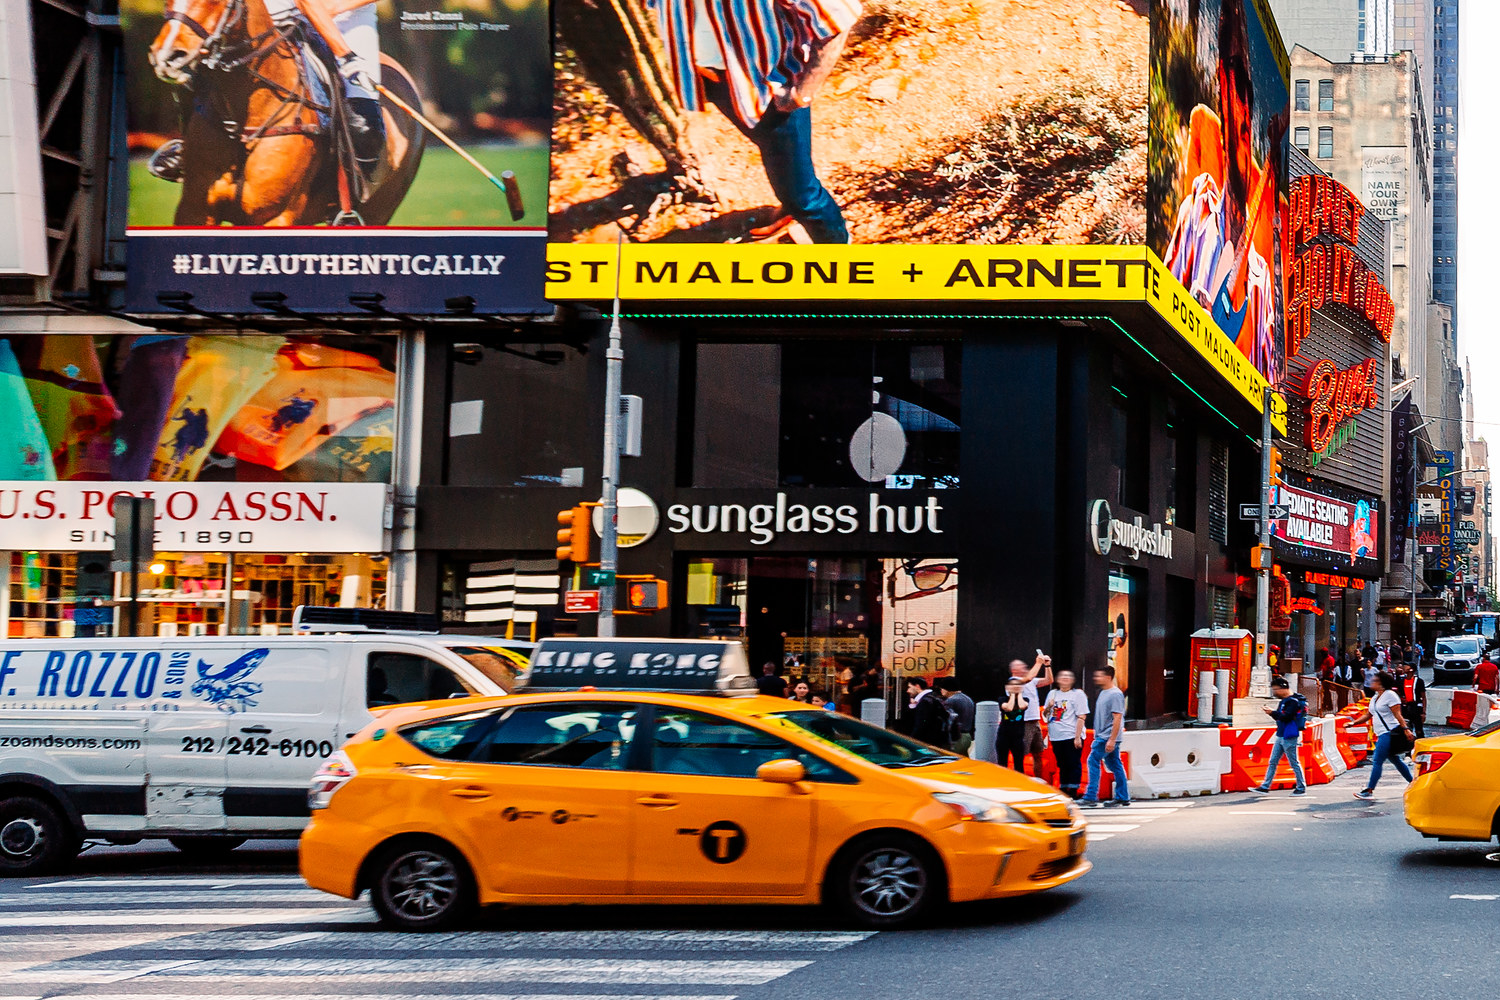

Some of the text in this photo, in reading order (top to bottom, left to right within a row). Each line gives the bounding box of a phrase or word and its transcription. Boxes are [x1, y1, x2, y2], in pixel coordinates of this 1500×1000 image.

[1368, 181, 1400, 190] NAME
[1369, 190, 1398, 198] YOUR
[1370, 199, 1397, 207] OWN
[1370, 207, 1398, 216] PRICE
[1288, 174, 1365, 277] PLANET
[172, 253, 506, 277] #LIVEAUTHENTICALLY
[636, 261, 875, 284] MALONE
[1287, 243, 1395, 357] HOLLYWOOD
[1172, 292, 1200, 338] POST
[1204, 326, 1241, 382] MALONE
[211, 491, 337, 522] ASSN.
[1316, 500, 1349, 527] SEATING
[667, 493, 944, 545] sunglass hut
[181, 531, 254, 544] 1890
[1111, 517, 1173, 561] sunglass hut
[1286, 517, 1333, 545] AVAILABLE!
[1418, 536, 1441, 545] RISE
[893, 621, 940, 637] BEST
[893, 639, 946, 654] GIFTS
[534, 651, 720, 671] KING KONG
[892, 657, 928, 672] FOR
[37, 650, 161, 698] ROZZO
[164, 652, 190, 685] SONS
